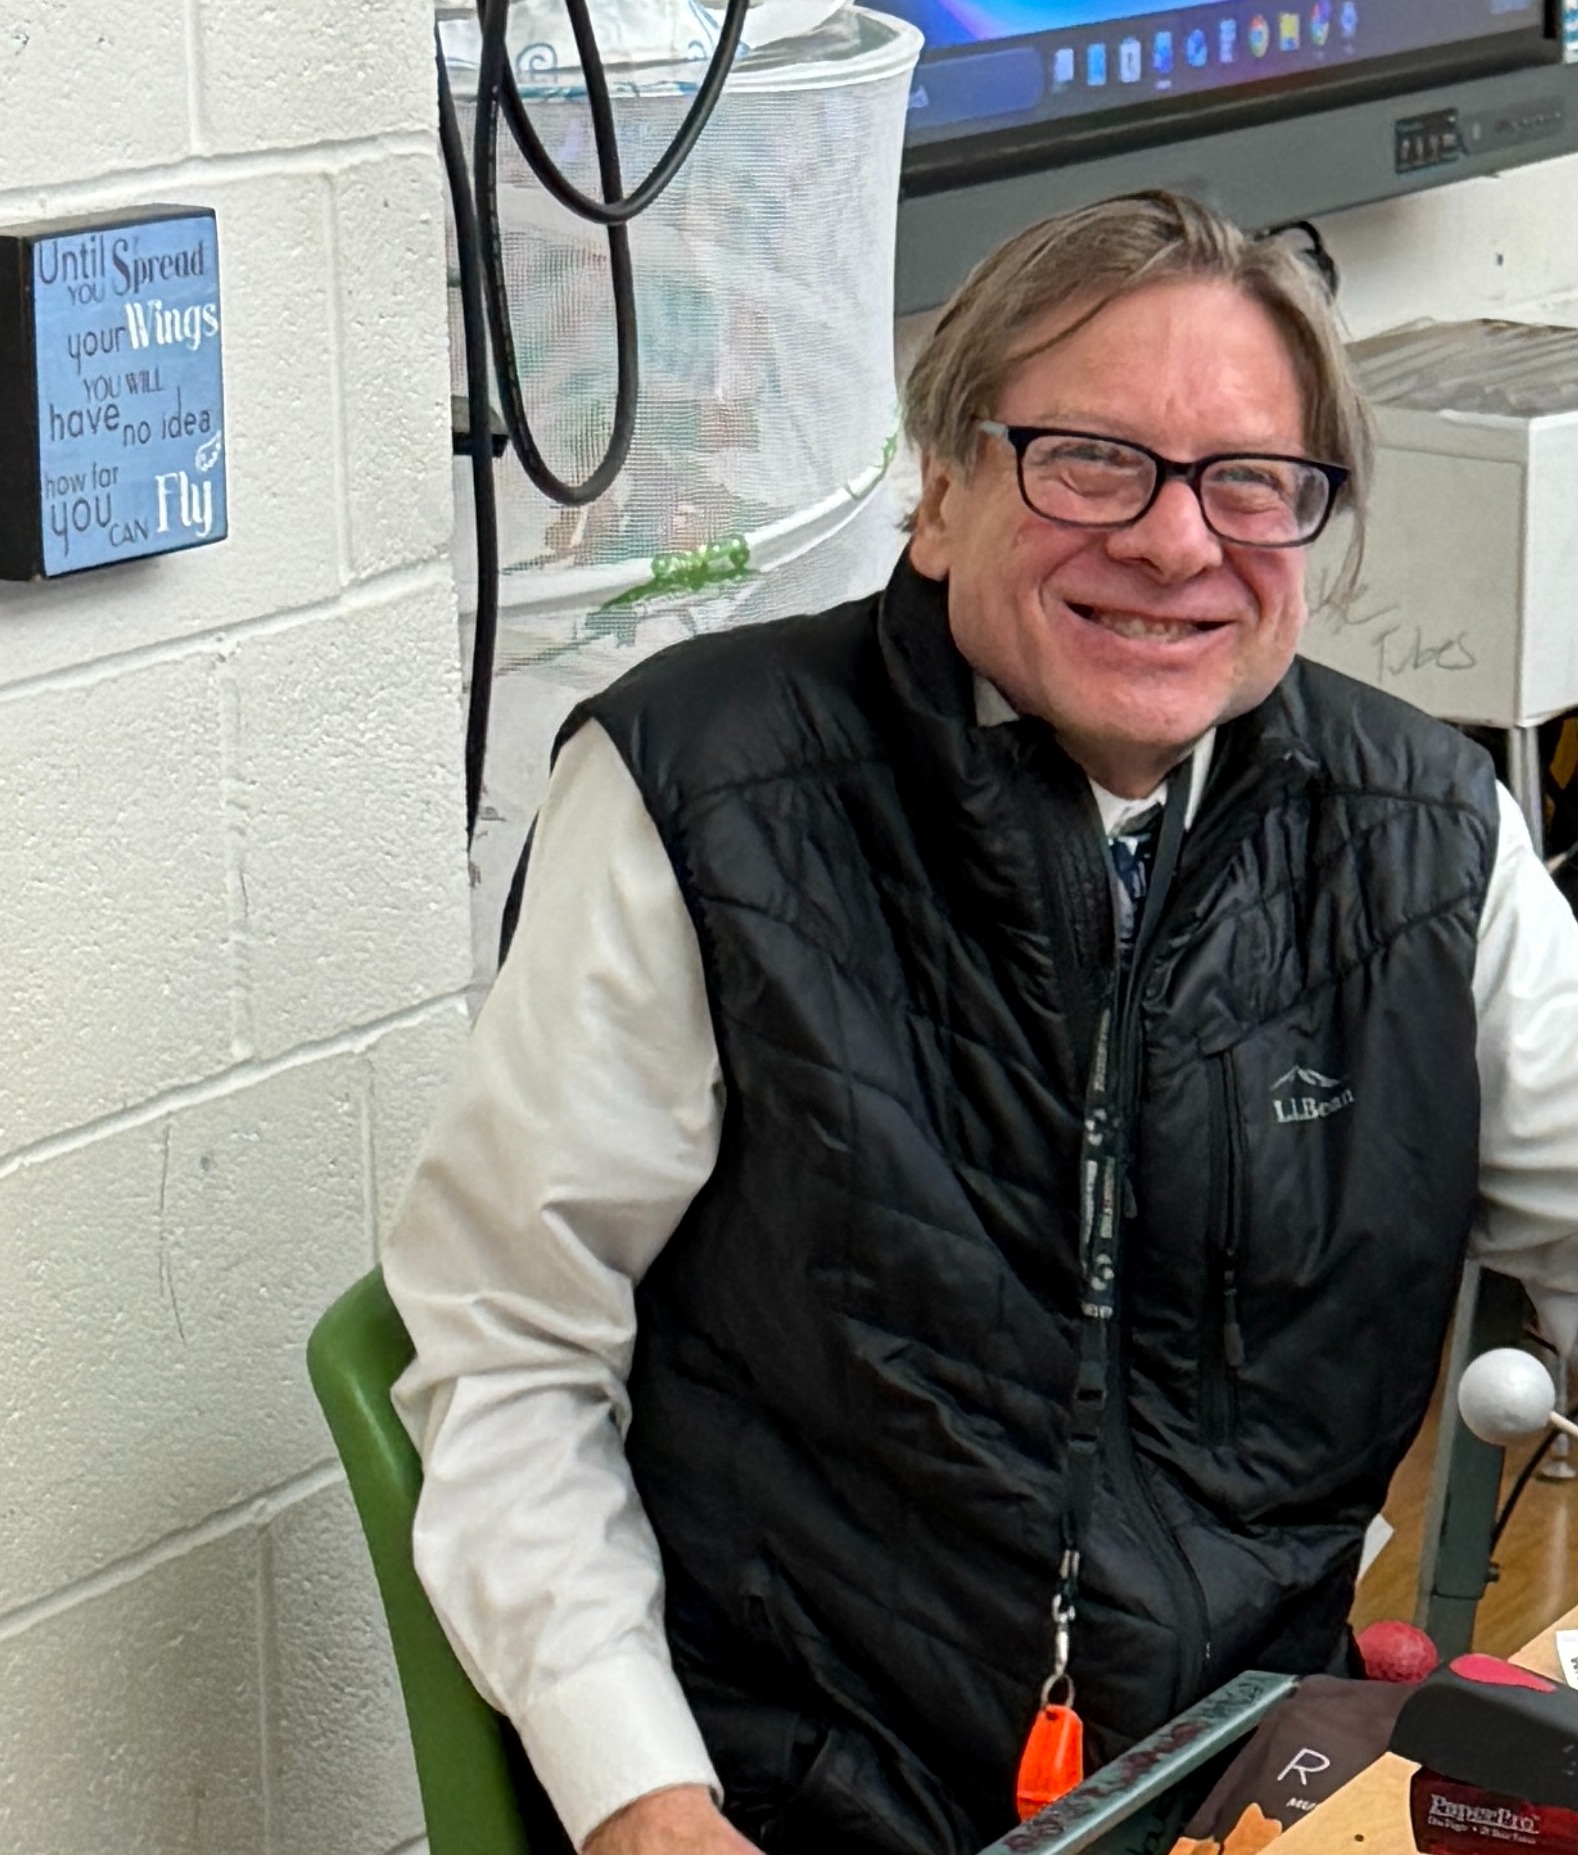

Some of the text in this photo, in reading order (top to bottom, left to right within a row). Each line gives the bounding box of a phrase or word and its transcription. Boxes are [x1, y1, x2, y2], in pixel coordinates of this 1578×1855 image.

[39, 236, 106, 285] Until
[66, 238, 206, 306] YOU Spread
[67, 299, 220, 374] your Wings
[83, 367, 165, 401] YOU WILL
[49, 386, 212, 447] have no idea
[44, 471, 87, 500] how
[109, 518, 150, 548] CAN
[154, 469, 214, 538] Fly
[1276, 1747, 1331, 1786] R
